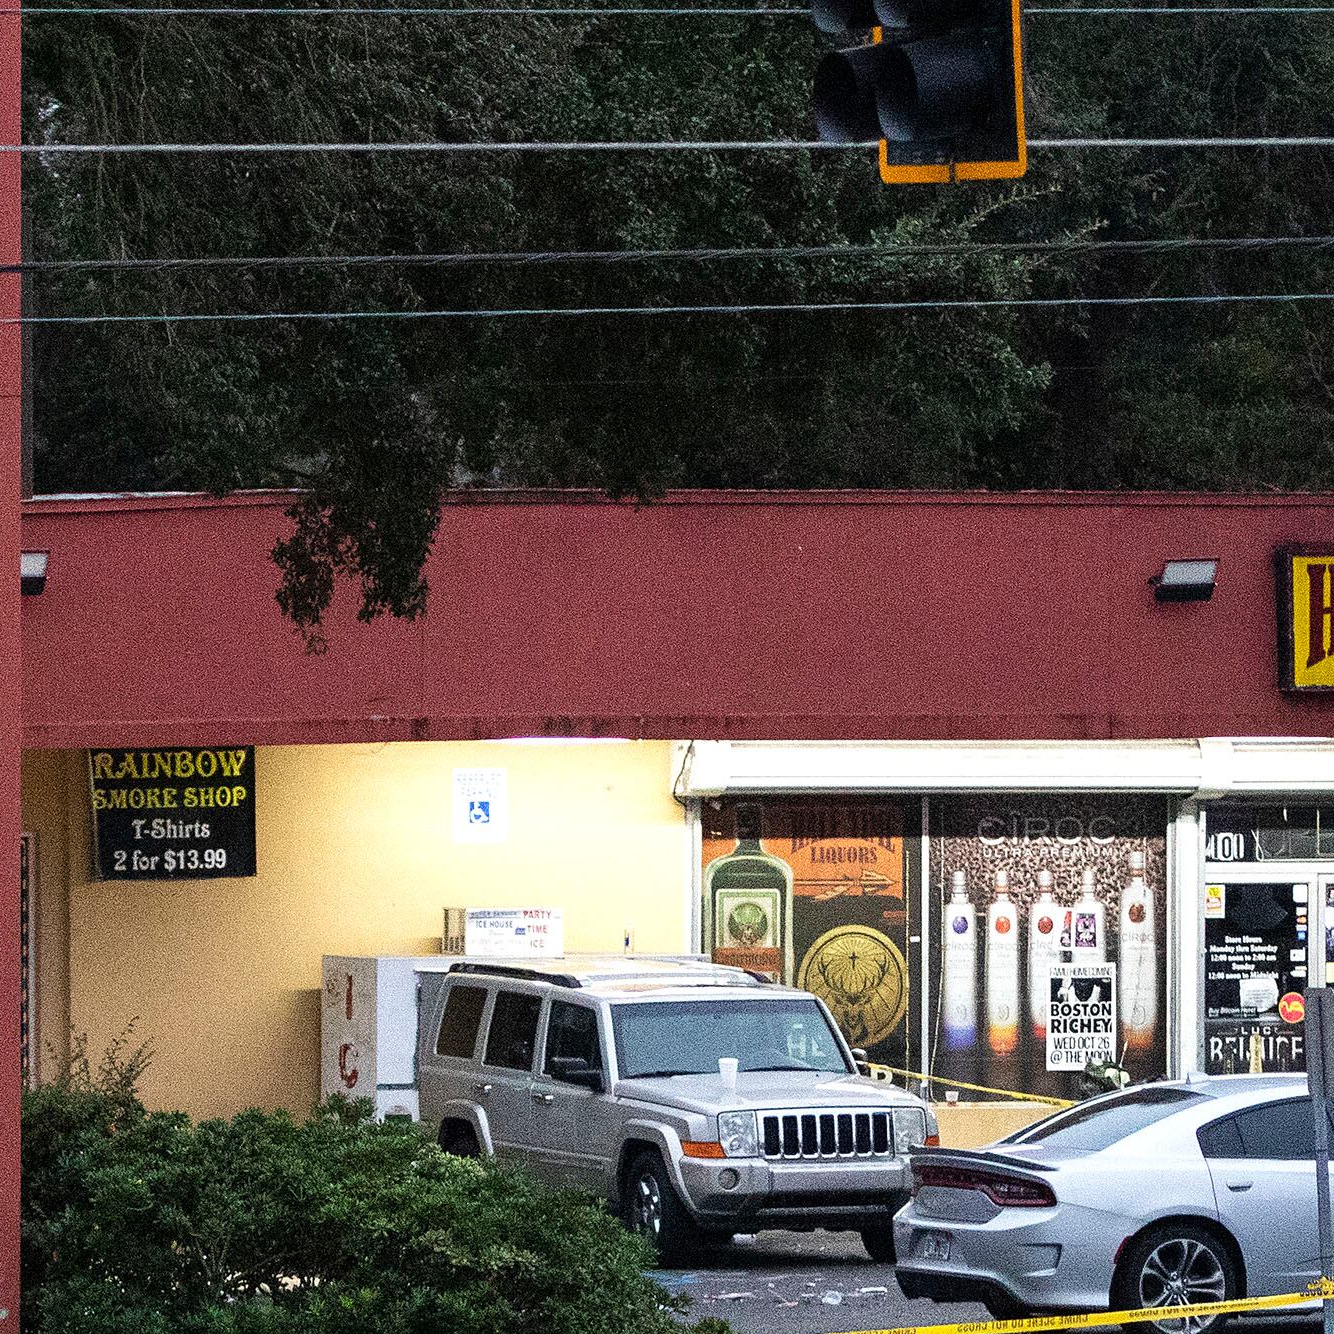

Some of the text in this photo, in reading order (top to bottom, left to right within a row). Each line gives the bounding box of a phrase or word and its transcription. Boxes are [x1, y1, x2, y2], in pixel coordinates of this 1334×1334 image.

[94, 750, 246, 778] RAINBOW
[93, 786, 247, 810] SMOKE SHOP
[131, 818, 211, 840] T-Shirts
[113, 848, 227, 872] 2 for $13.99
[811, 846, 878, 864] LIQUORS
[1050, 1003, 1112, 1016] BOSTON
[1050, 1019, 1112, 1033] RICHEY
[1053, 1037, 1110, 1050] WED OCT 26
[1050, 1050, 1063, 1064] @
[1064, 1050, 1082, 1063] THE
